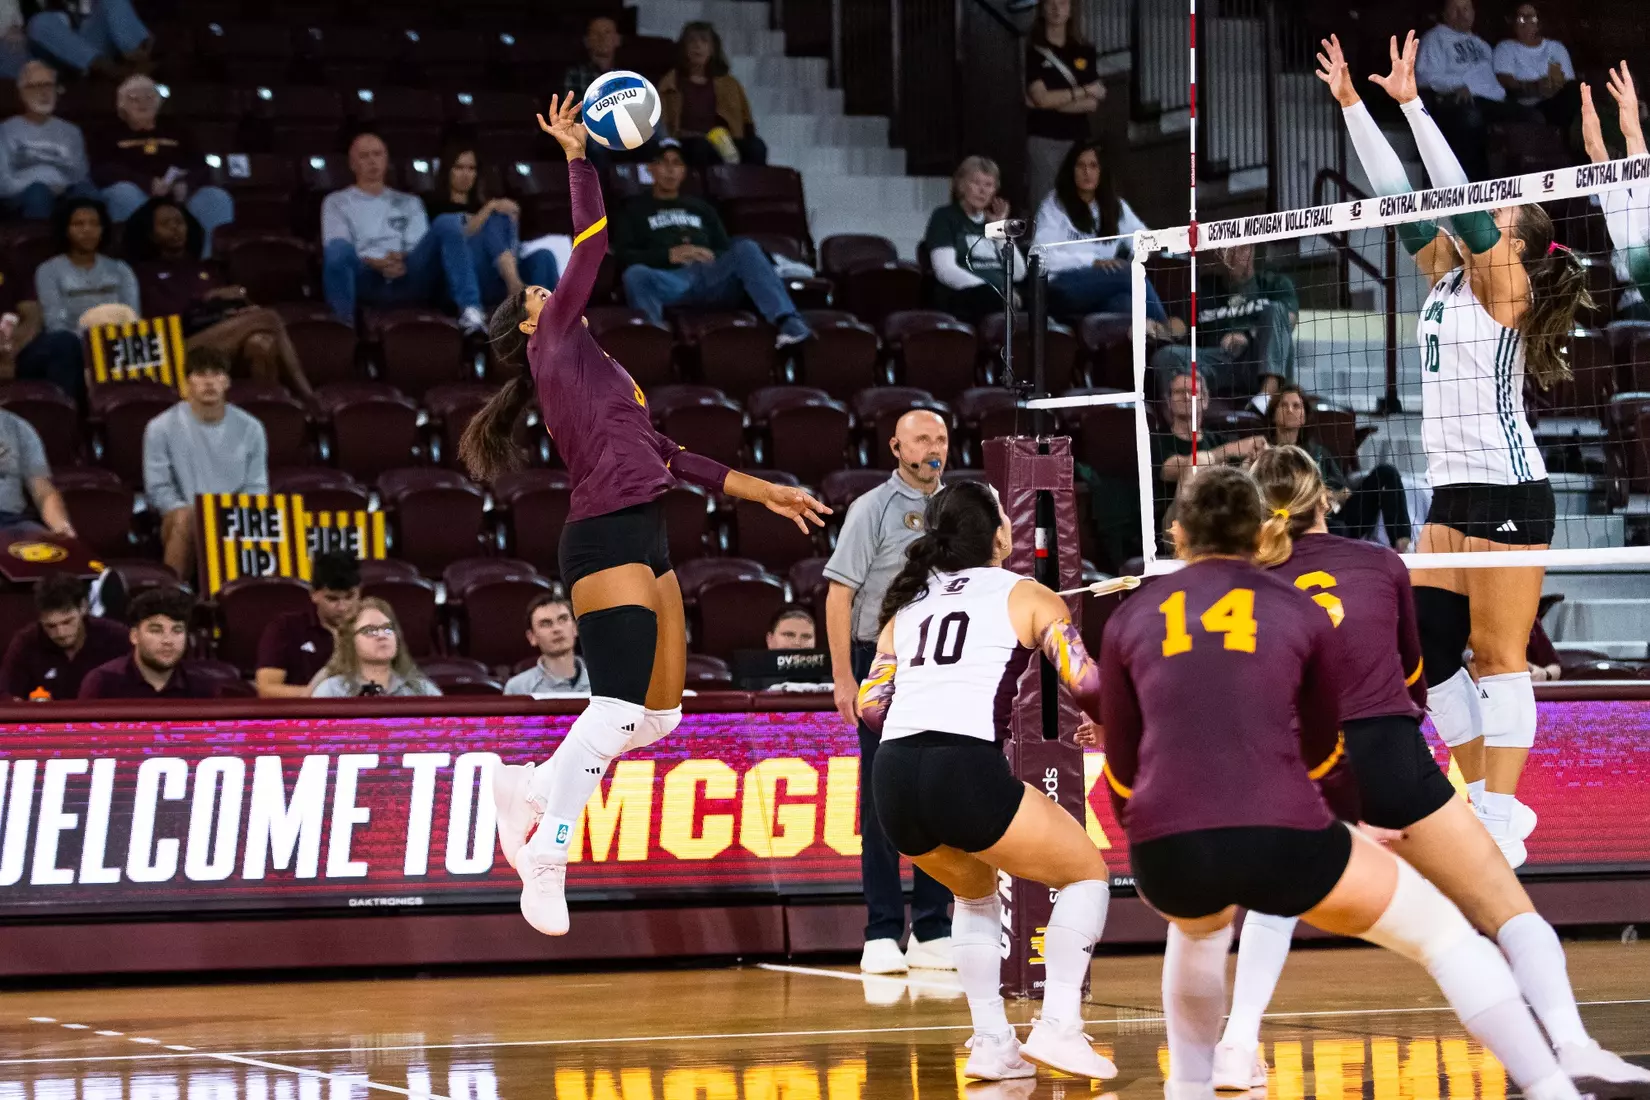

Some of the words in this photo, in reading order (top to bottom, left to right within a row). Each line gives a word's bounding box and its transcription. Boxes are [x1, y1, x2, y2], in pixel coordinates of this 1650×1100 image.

[595, 88, 637, 111] molten
[1576, 162, 1618, 189] CENTRAL
[1379, 193, 1418, 217] CENTRAL
[1420, 185, 1465, 211] MICHIGAN
[1467, 177, 1523, 204] VOLLEYBALL
[1208, 222, 1241, 242] CENTRAL
[1243, 213, 1283, 238] MICHIGAN
[1285, 206, 1334, 232] VOLLEYBALL
[107, 332, 167, 371] FIRE
[220, 507, 285, 542] FIRE
[909, 610, 970, 667] 10
[1159, 587, 1258, 658] 14
[402, 752, 502, 876] TO
[348, 896, 424, 907] DAKTRONICS
